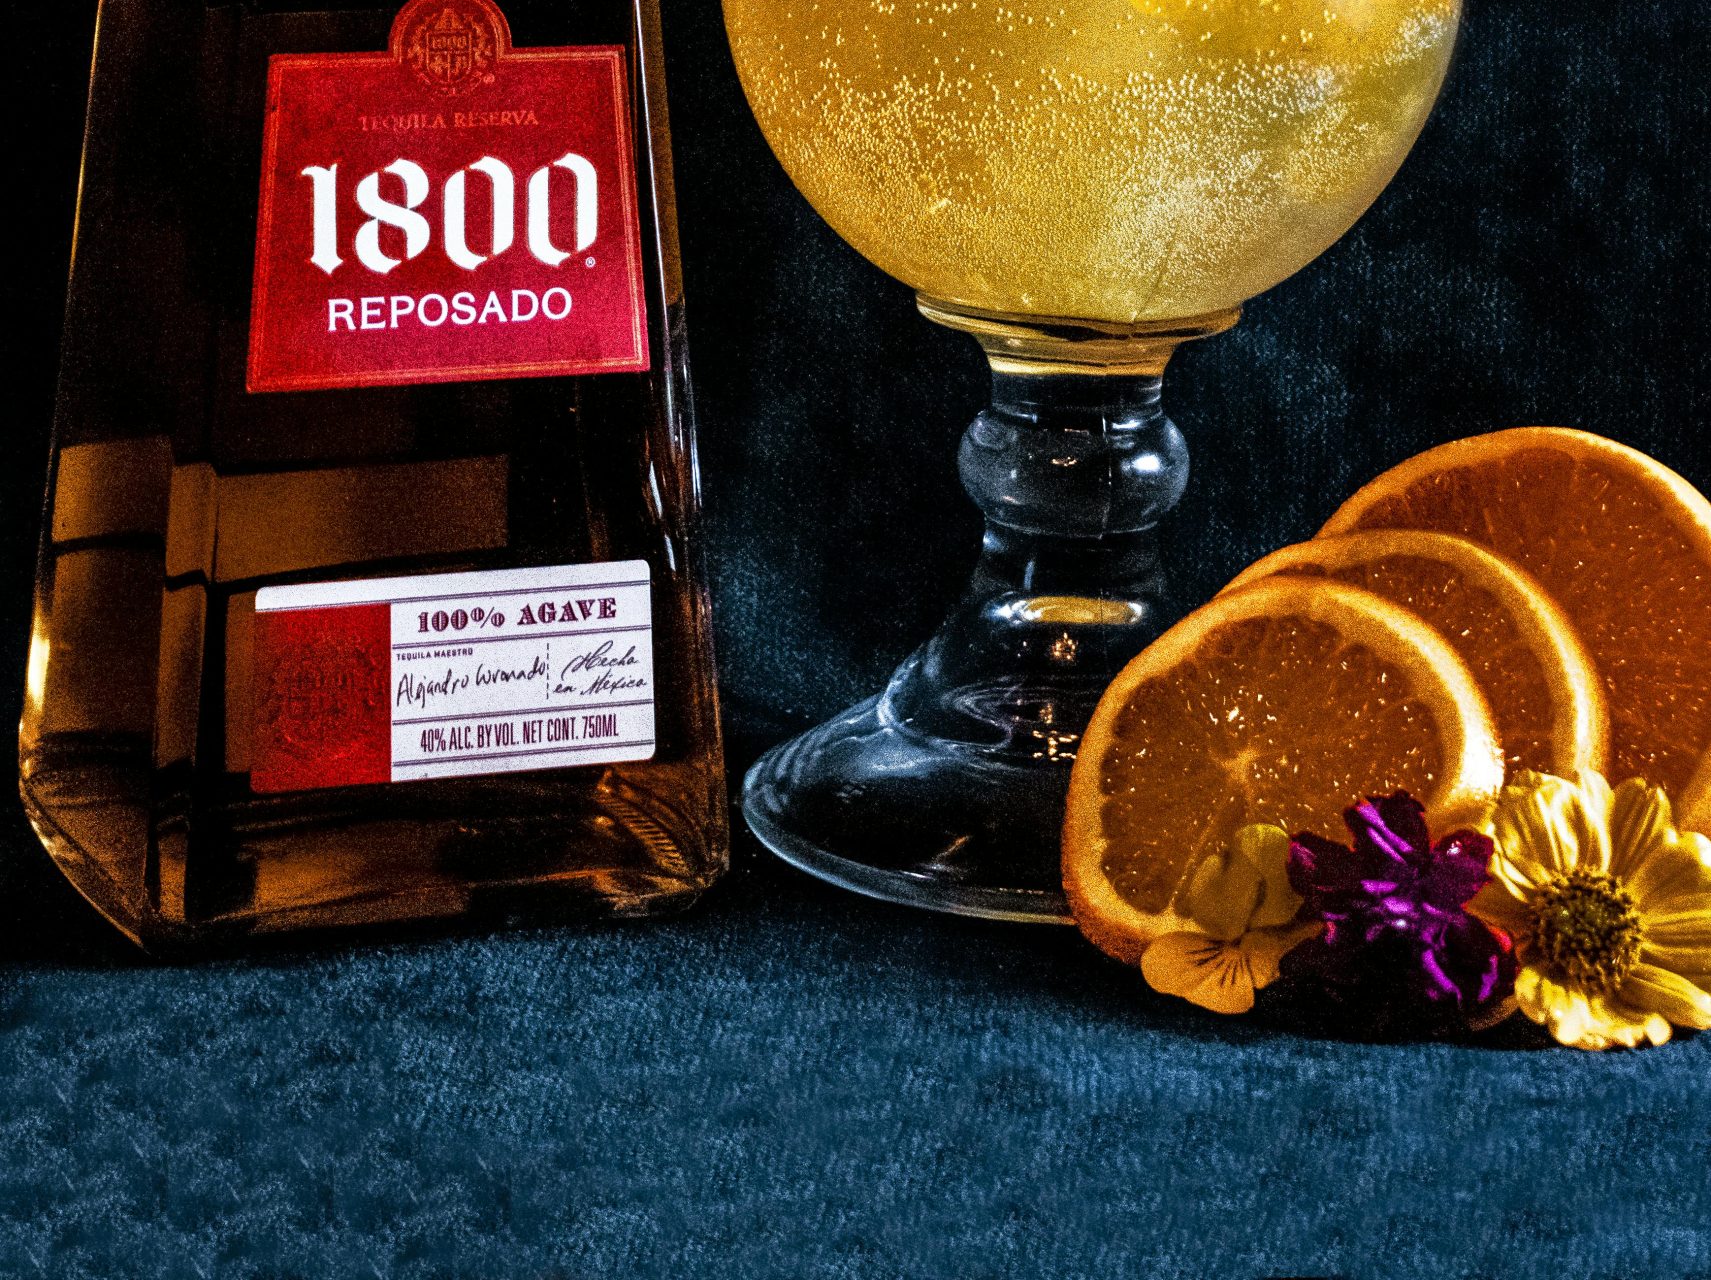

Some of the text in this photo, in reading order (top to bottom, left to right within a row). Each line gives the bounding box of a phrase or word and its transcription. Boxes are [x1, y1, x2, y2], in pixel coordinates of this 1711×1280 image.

[357, 108, 539, 132] TEQUILA RESERVA
[300, 152, 598, 275] 1800
[326, 287, 573, 332] REPOSADO
[417, 597, 618, 633] 100% AGAVE
[397, 647, 474, 661] TEQUILA MAESTRO
[553, 683, 577, 694] en
[420, 714, 619, 752] 40% ALC. BY VOL. NET CONT. 750ML
